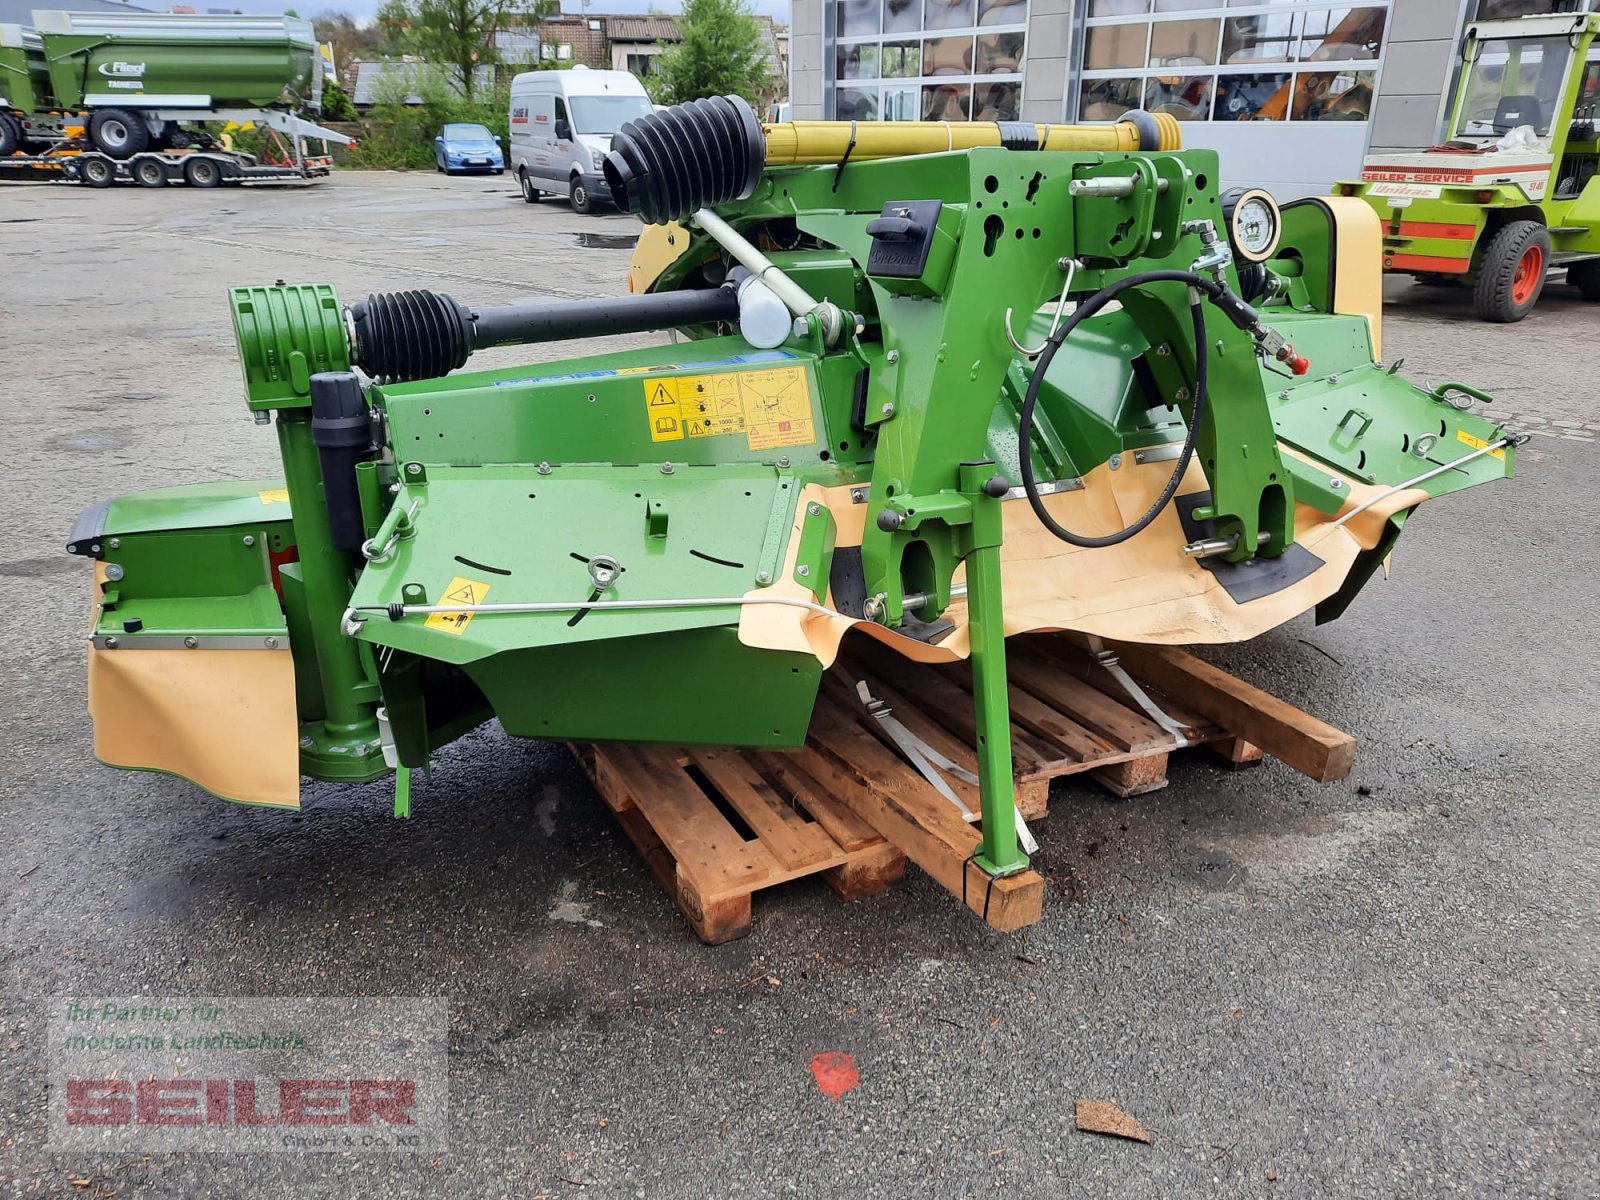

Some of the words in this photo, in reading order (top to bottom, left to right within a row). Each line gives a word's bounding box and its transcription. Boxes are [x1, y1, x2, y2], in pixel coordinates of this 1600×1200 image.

[113, 61, 146, 76] Fliegl
[1361, 172, 1475, 184] SEILER-SERVICE
[1374, 185, 1432, 197] Unitrac
